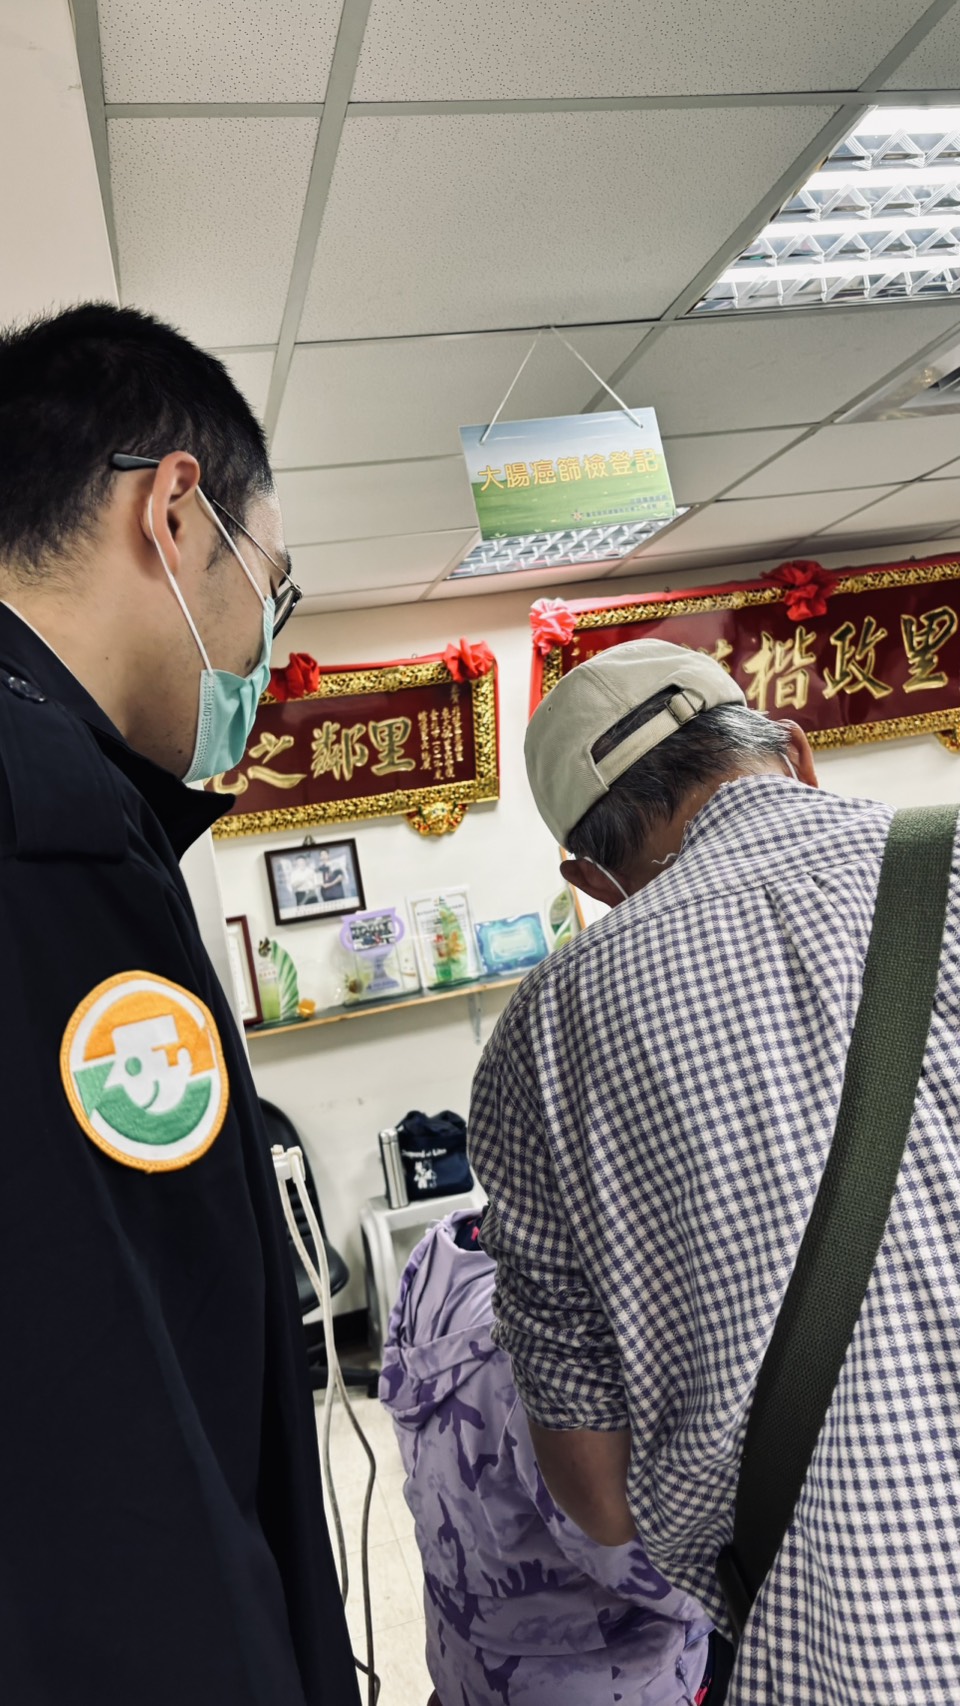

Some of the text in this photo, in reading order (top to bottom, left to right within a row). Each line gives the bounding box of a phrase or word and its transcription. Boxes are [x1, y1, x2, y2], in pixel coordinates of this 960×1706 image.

[477, 447, 660, 492] 大腸癌篩檢登記
